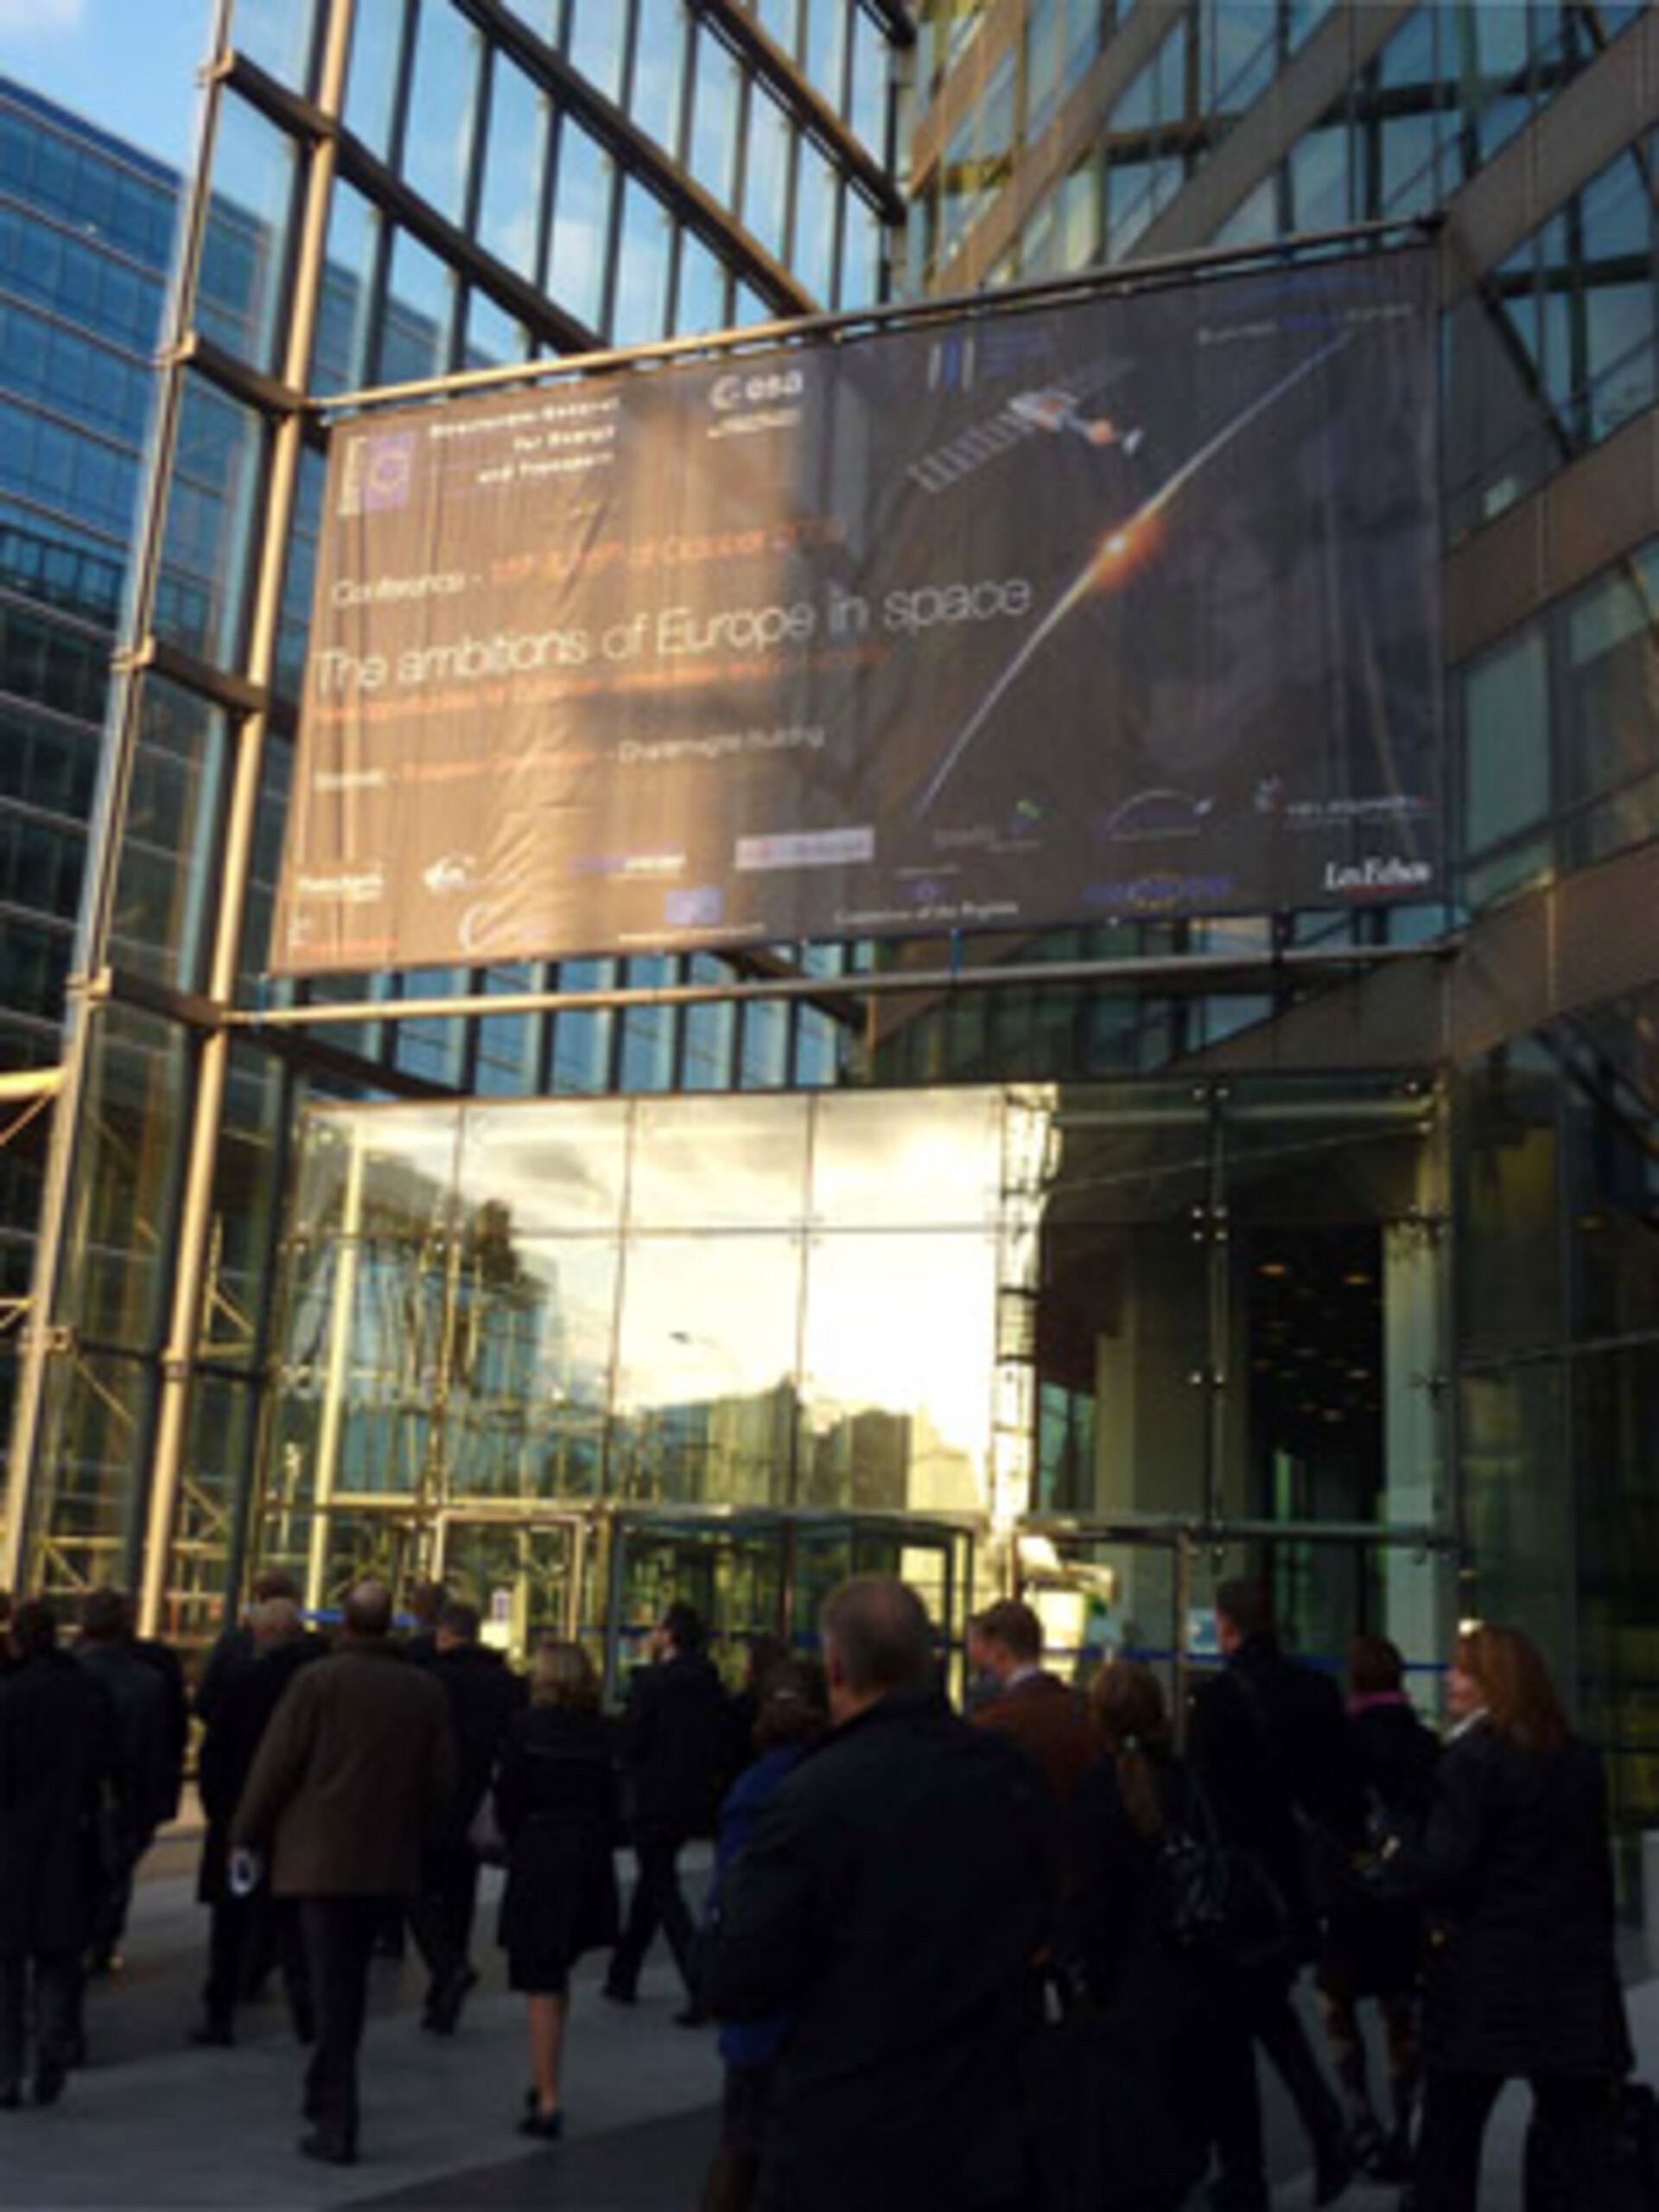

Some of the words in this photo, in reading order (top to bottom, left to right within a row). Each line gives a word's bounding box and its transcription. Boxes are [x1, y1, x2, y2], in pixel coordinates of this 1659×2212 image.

[315, 646, 388, 695] The
[397, 626, 588, 682] ambitions
[602, 612, 650, 660] of
[657, 600, 816, 655] Europe
[828, 582, 869, 632] in
[883, 579, 1031, 637] space
